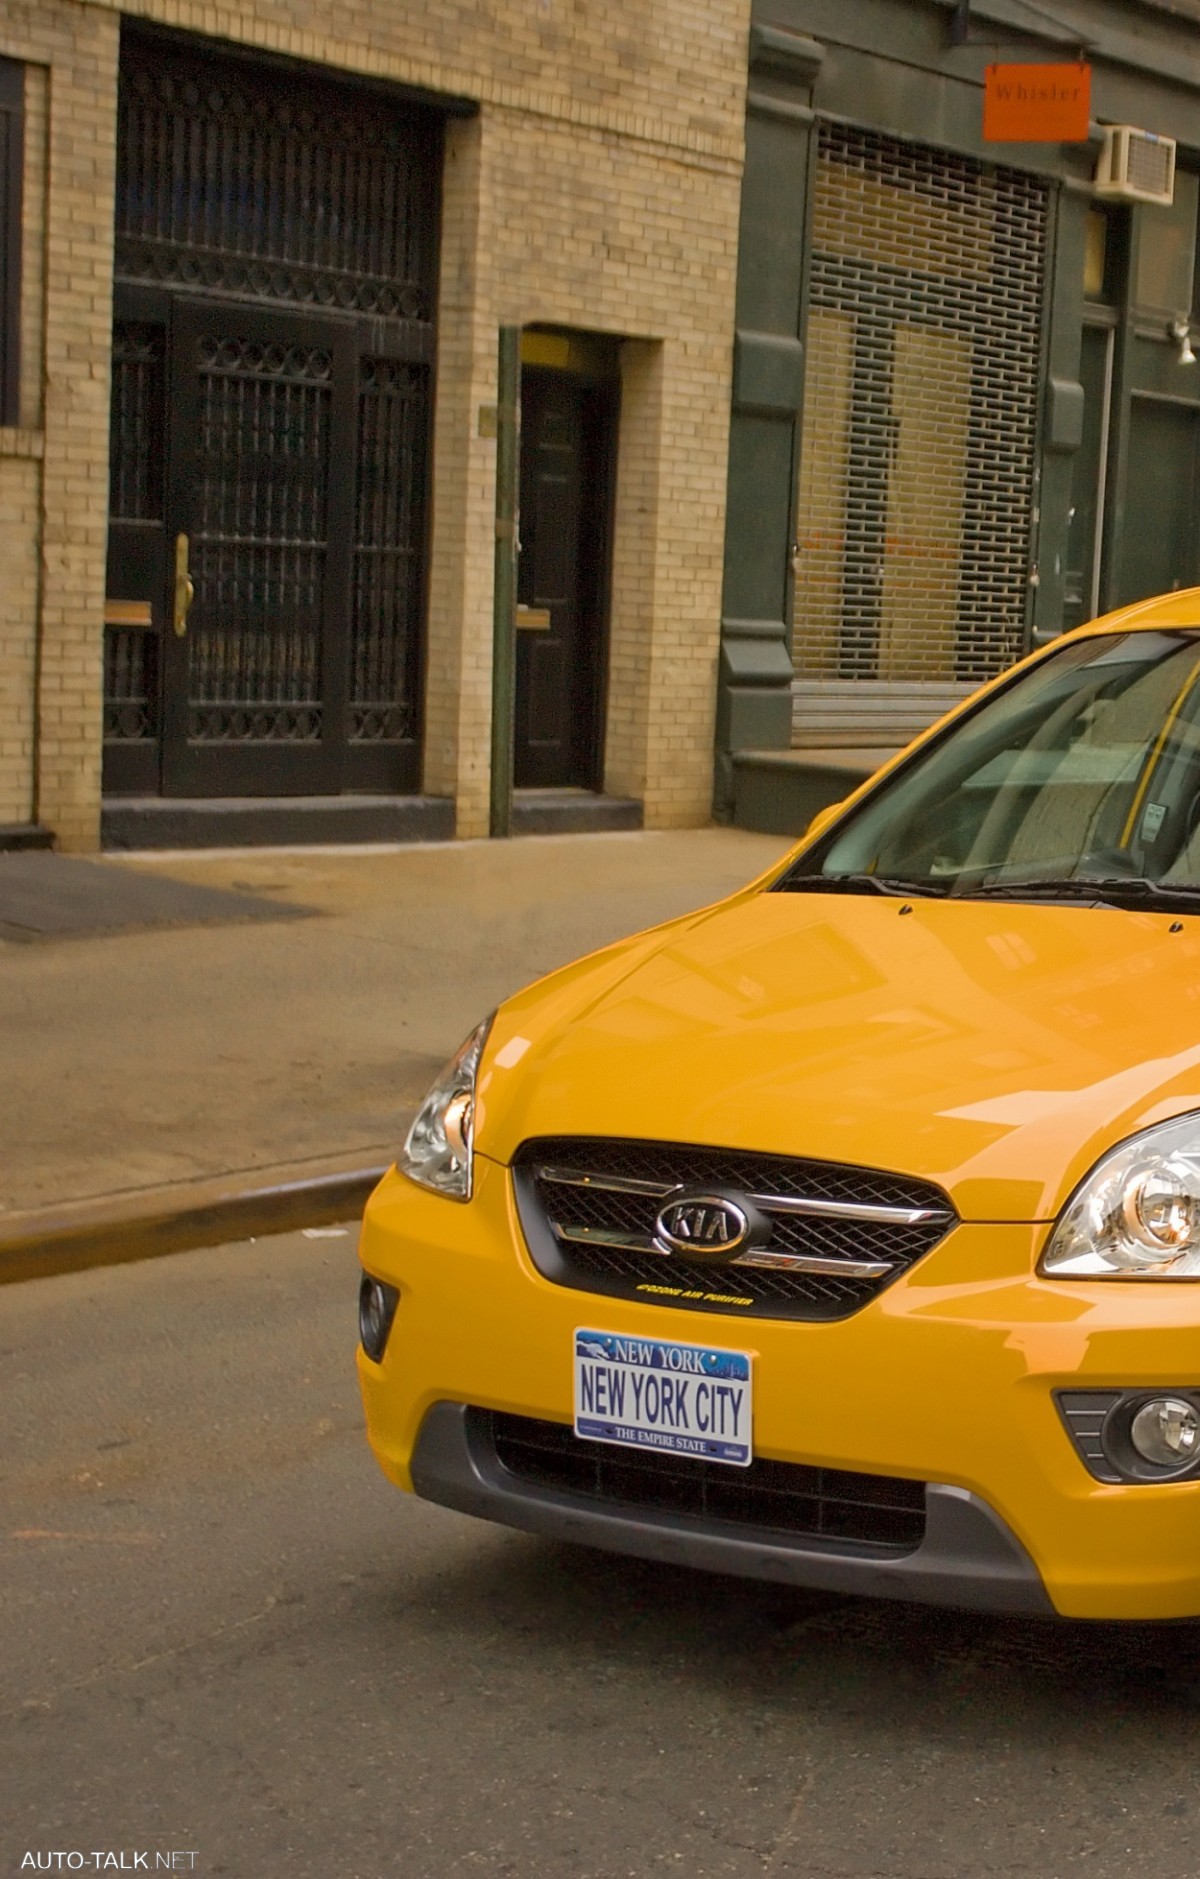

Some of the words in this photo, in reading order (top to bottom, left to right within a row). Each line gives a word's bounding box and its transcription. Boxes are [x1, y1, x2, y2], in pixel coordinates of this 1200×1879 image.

[671, 1206, 728, 1241] KIA
[680, 1290, 703, 1299] AIR
[703, 1293, 754, 1306] PURIFIER
[614, 1339, 654, 1366] NEW
[658, 1346, 706, 1374] YORK
[581, 1363, 626, 1418] NEW
[631, 1371, 689, 1428] YORK
[696, 1381, 743, 1437] CITY
[614, 1426, 636, 1440] THE
[637, 1431, 674, 1447] EMPIRE
[675, 1437, 706, 1453] STATE
